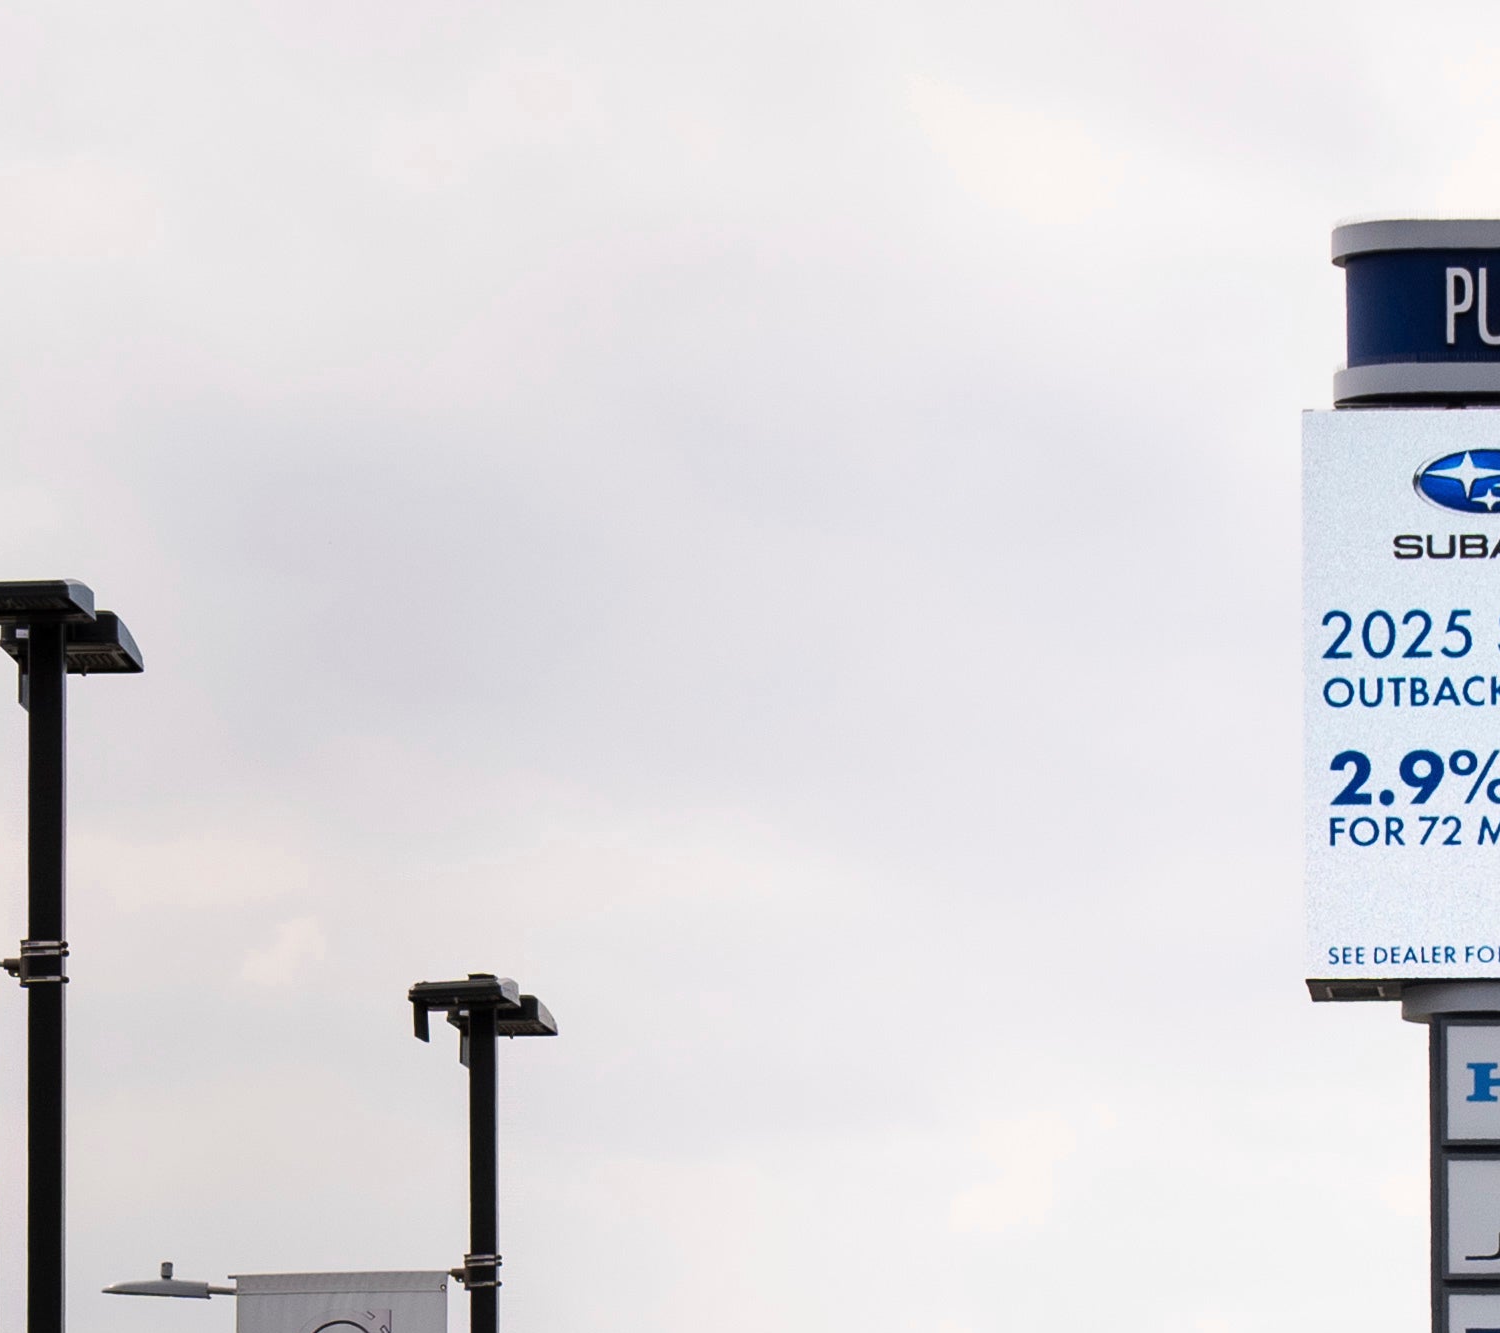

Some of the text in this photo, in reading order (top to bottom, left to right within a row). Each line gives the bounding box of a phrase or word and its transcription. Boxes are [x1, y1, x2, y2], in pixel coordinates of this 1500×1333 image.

[1320, 608, 1473, 660] 2025
[1328, 815, 1410, 847] FOR
[1417, 815, 1466, 846] 72
[1327, 945, 1366, 964] SEE
[1372, 945, 1458, 964] DEALER
